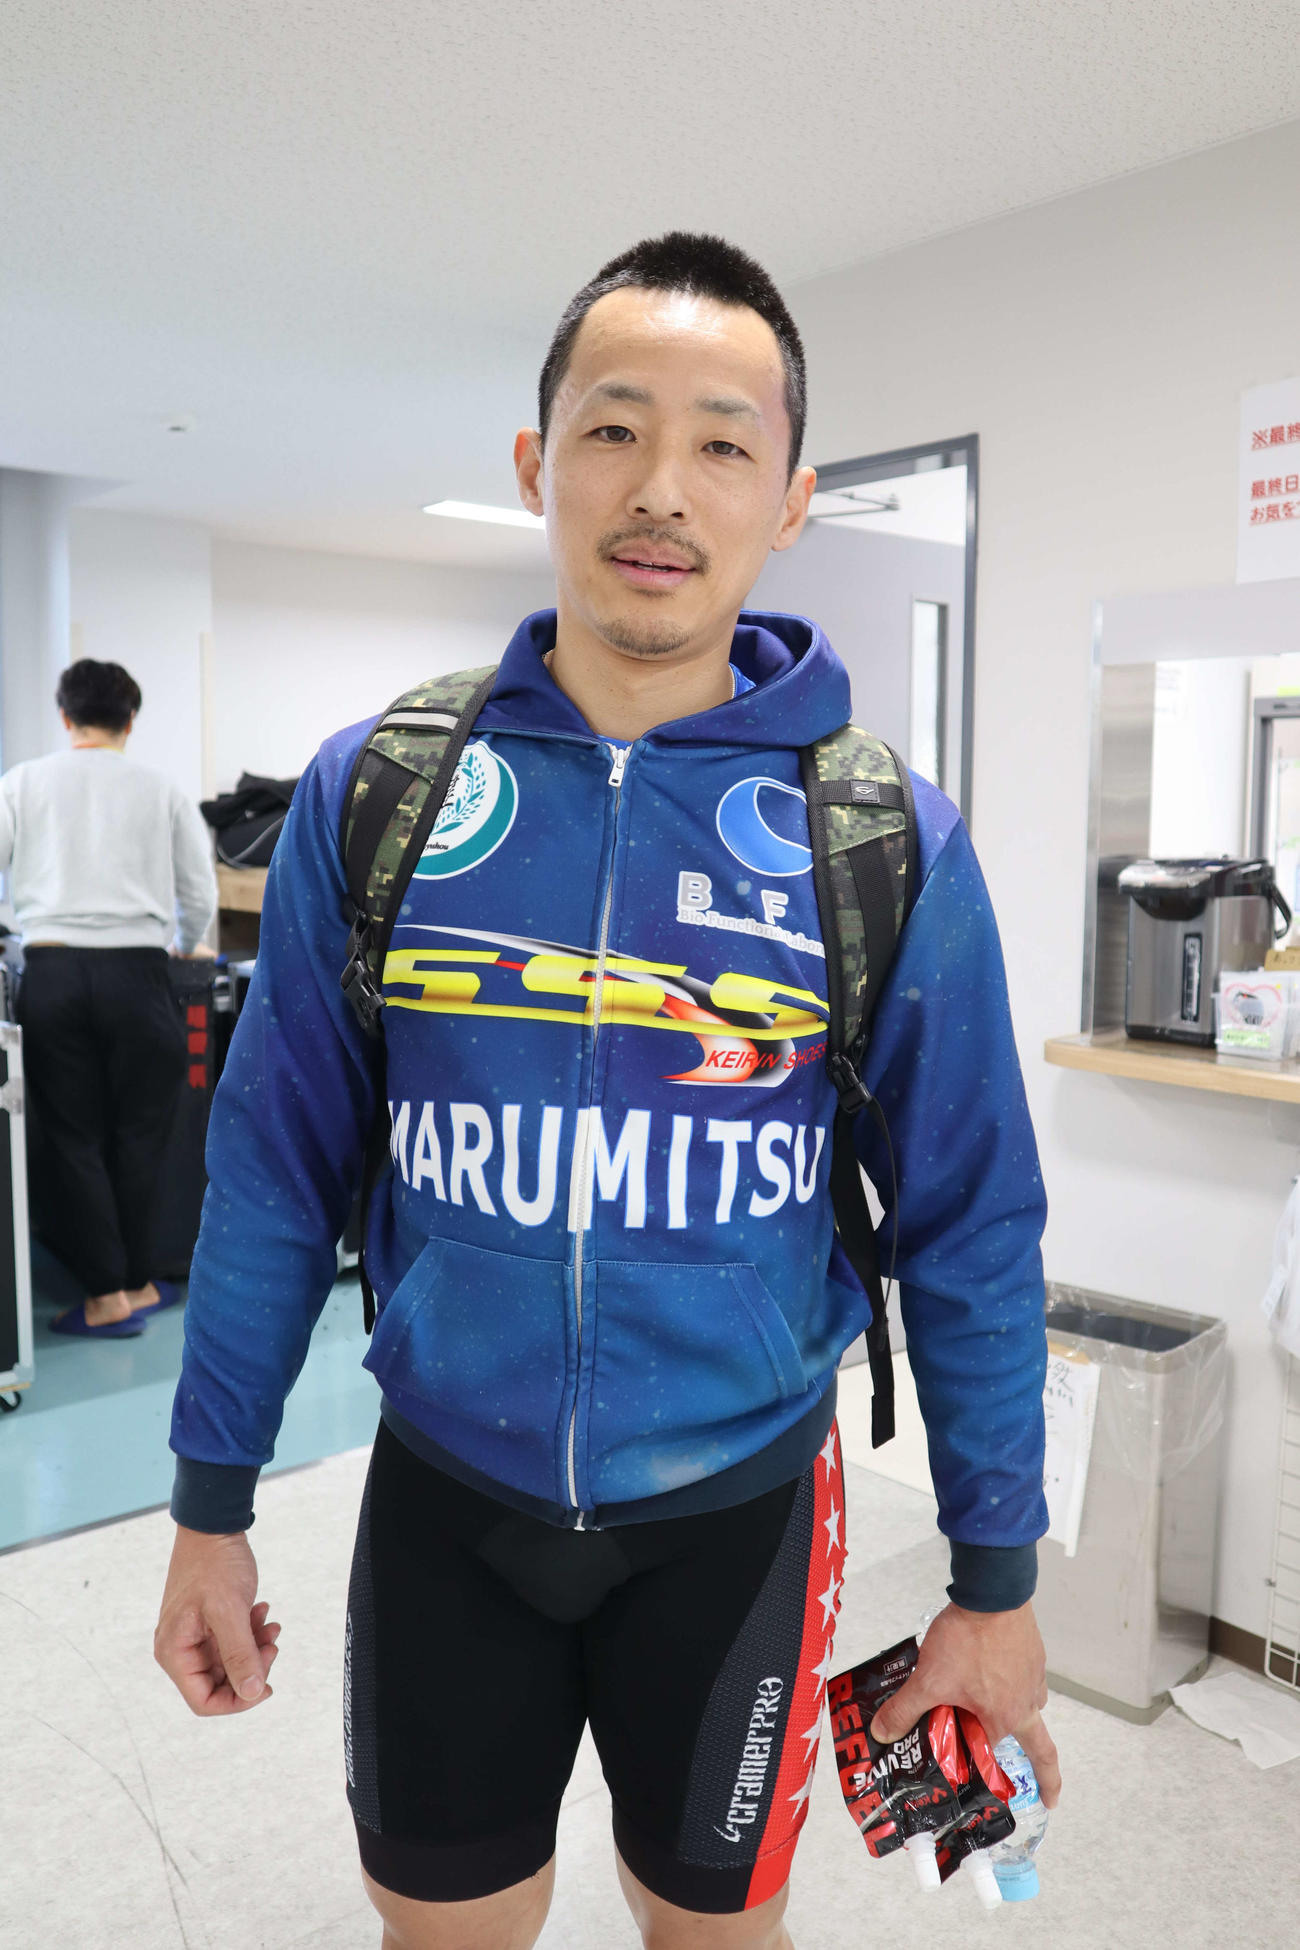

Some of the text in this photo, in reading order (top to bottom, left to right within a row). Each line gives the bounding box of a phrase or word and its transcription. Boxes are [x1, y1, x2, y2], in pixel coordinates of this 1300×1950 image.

[1251, 474, 1299, 499] 最終日
[678, 871, 789, 925] B F
[677, 907, 706, 925] Bio
[705, 1050, 782, 1069] KEIRIN
[387, 1100, 825, 1232] MARUMITSU
[893, 1727, 920, 1755] PRO
[853, 1742, 923, 1792] REVIVE
